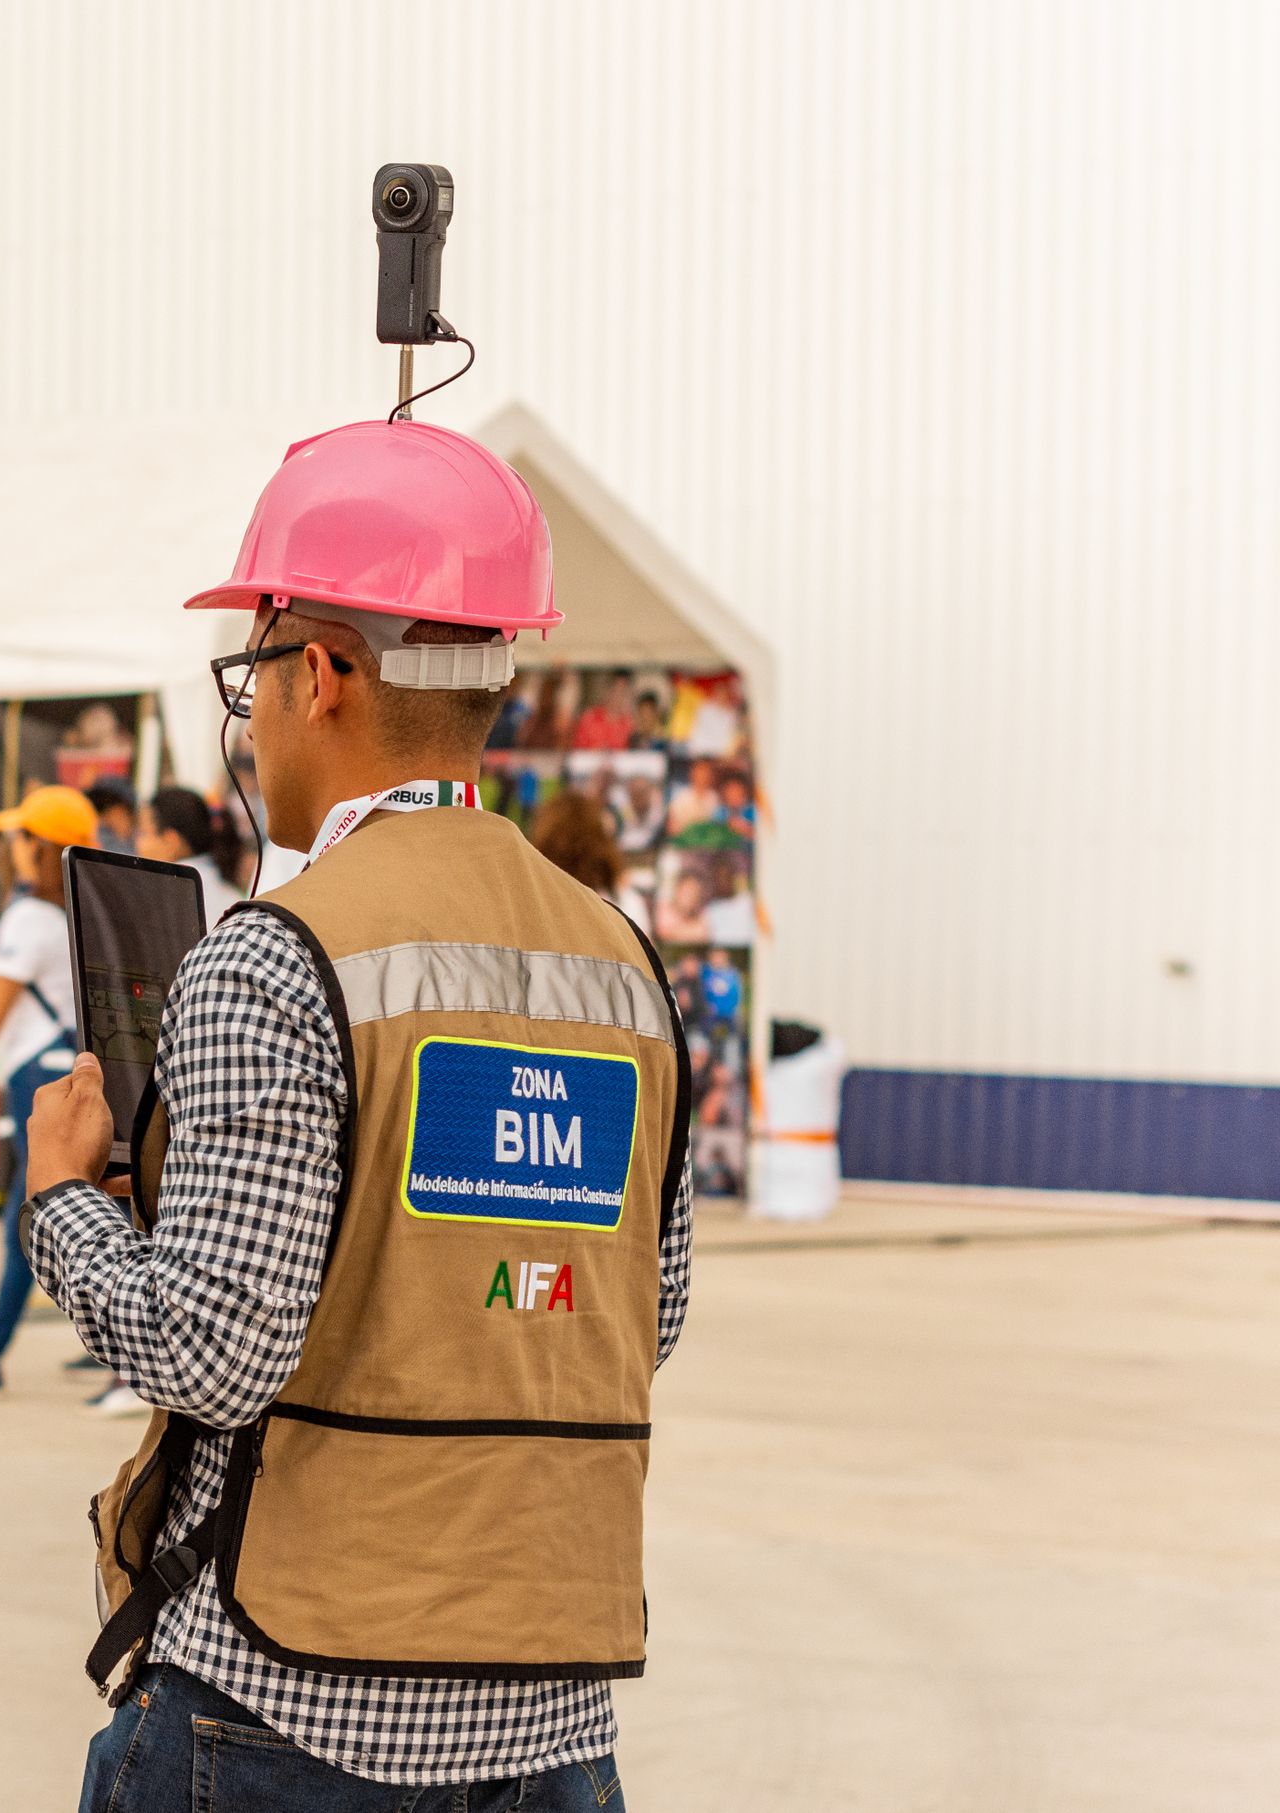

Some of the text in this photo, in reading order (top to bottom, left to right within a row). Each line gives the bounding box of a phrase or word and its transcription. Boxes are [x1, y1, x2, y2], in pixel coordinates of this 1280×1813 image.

[384, 790, 434, 805] RBUS
[512, 1066, 568, 1101] ZONA
[495, 1109, 582, 1168] BIM
[411, 1173, 474, 1194] Modelado
[475, 1178, 489, 1196] de
[491, 1180, 549, 1200] Información
[551, 1187, 573, 1205] para
[573, 1186, 581, 1202] la
[485, 1261, 574, 1312] AIFA
